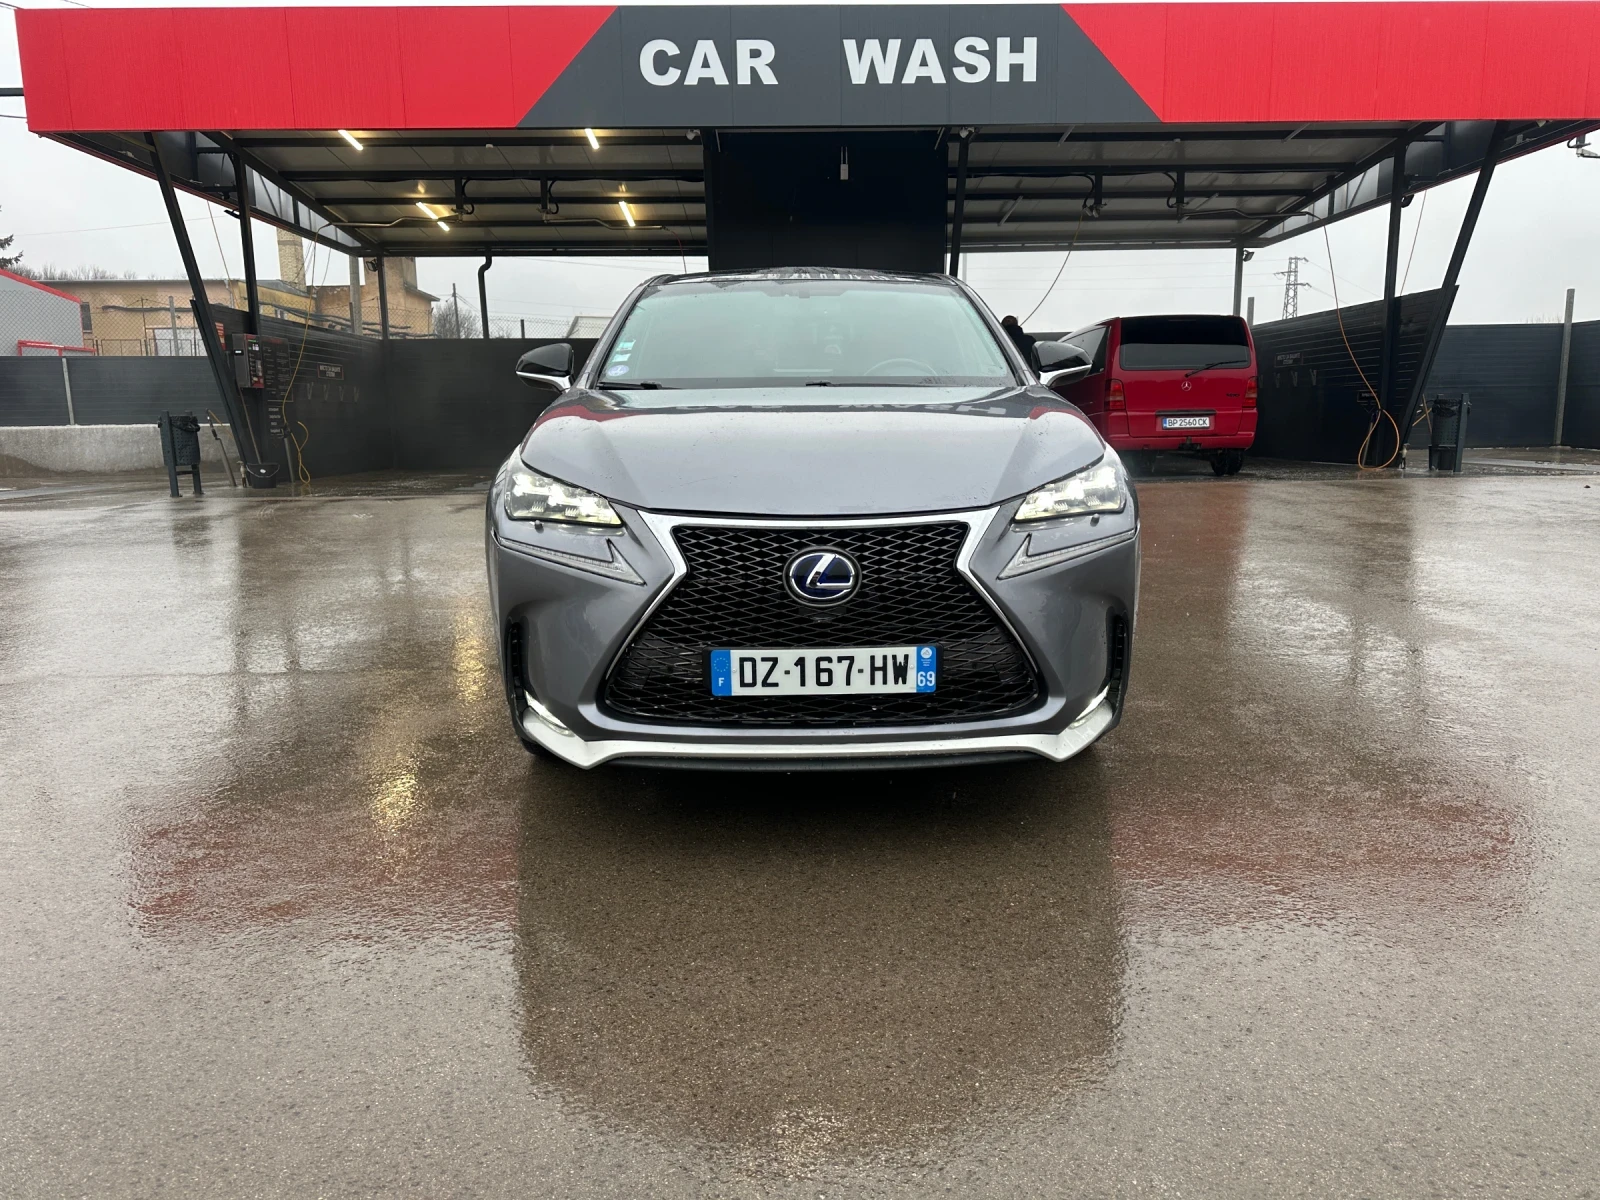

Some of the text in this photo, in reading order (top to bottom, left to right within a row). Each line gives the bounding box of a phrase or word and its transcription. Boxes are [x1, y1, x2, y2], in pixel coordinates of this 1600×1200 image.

[639, 36, 1038, 86] CAR WASH
[1168, 418, 1208, 426] BP 2560 CK
[739, 653, 910, 688] DZ-167-HW
[718, 677, 725, 687] F
[917, 671, 935, 687] 69
